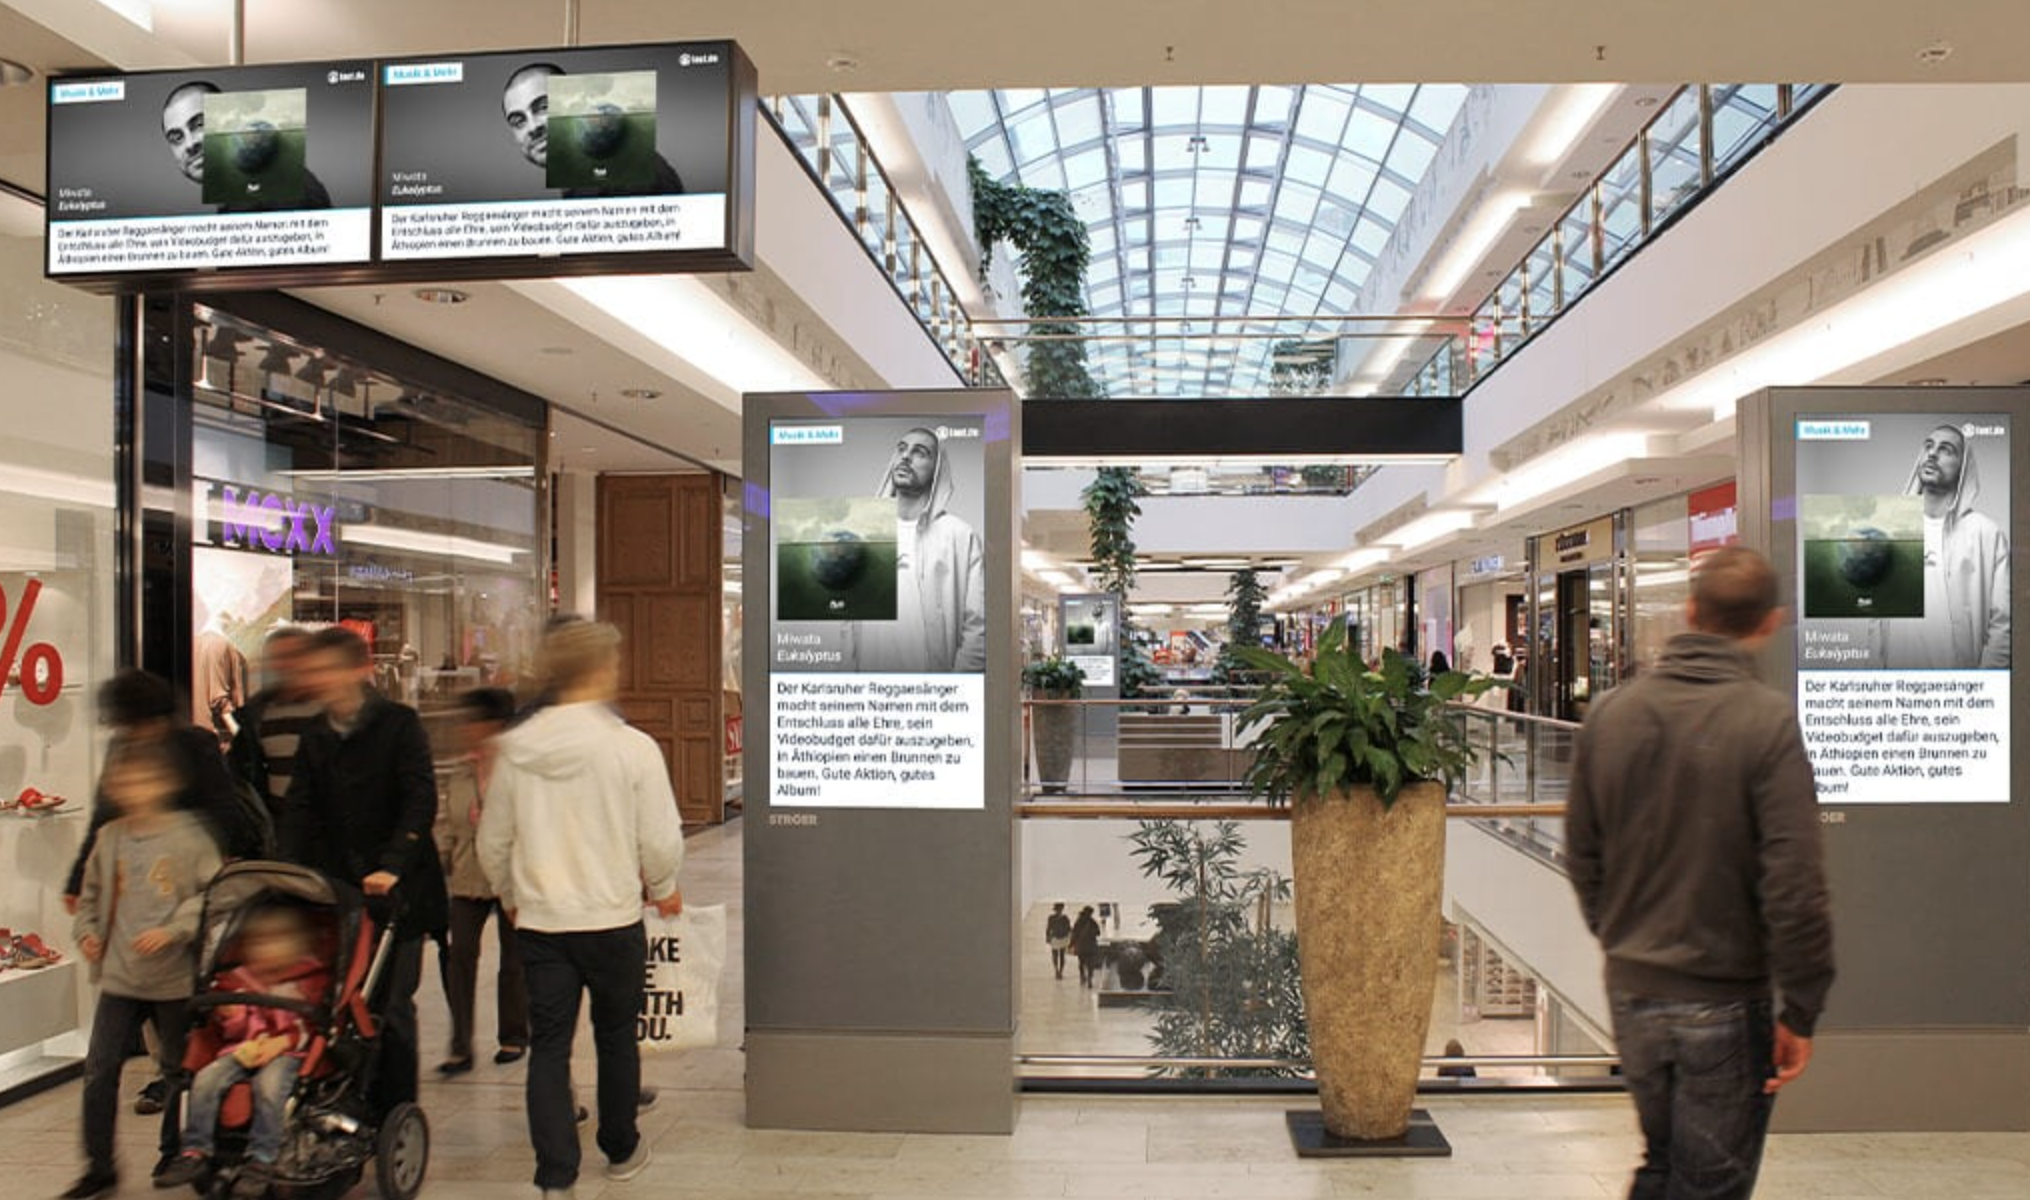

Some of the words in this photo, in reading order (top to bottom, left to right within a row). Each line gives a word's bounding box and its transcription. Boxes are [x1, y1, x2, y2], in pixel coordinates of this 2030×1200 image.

[777, 633, 821, 645] Miwata
[777, 650, 841, 663] Eukalyptus
[1805, 648, 1869, 661] Eukalyptus
[777, 683, 799, 694] Der
[801, 682, 863, 694] Karlsruher
[1805, 680, 1826, 692] Der
[1830, 680, 1893, 692] Karlsruher
[777, 699, 816, 711] macht
[820, 700, 865, 711] seinem
[868, 700, 912, 711] Namen
[916, 699, 937, 711] mit
[940, 699, 969, 711] dem
[1805, 697, 1844, 709] macht
[1848, 697, 1892, 709] seinem
[1896, 697, 1940, 709] Namen
[1944, 697, 1964, 709] mit
[1967, 697, 1994, 709] dem
[777, 716, 844, 728] Entschluss
[848, 716, 870, 728] alle
[873, 717, 904, 730] Ehre,
[907, 716, 933, 728] sein
[1805, 714, 1873, 726] Entschluss
[1876, 714, 1898, 726] alle
[1901, 714, 1931, 727] Ehre,
[1934, 714, 1960, 726] sein
[777, 733, 855, 747] Videobudget
[859, 733, 891, 745] dafür
[895, 734, 974, 749] auszugeben,
[1806, 731, 1883, 745] Videobudget
[1887, 731, 1919, 743] dafür
[1923, 731, 1999, 745] auszugeben,
[854, 751, 886, 762] einen
[891, 751, 942, 763] Brunnen
[945, 753, 961, 763] zu
[1882, 748, 1914, 759] einen
[1919, 747, 1969, 759] Brunnen
[1972, 749, 1987, 759] zu
[822, 768, 850, 779] Gute
[854, 767, 897, 782] Aktion,
[900, 768, 935, 782] gutes
[1850, 764, 1880, 776] Gute
[1928, 765, 1962, 778] gutes
[777, 785, 821, 796] Album!
[648, 936, 681, 962] KE
[641, 990, 683, 1015] ITH
[635, 1016, 671, 1041] OU.
